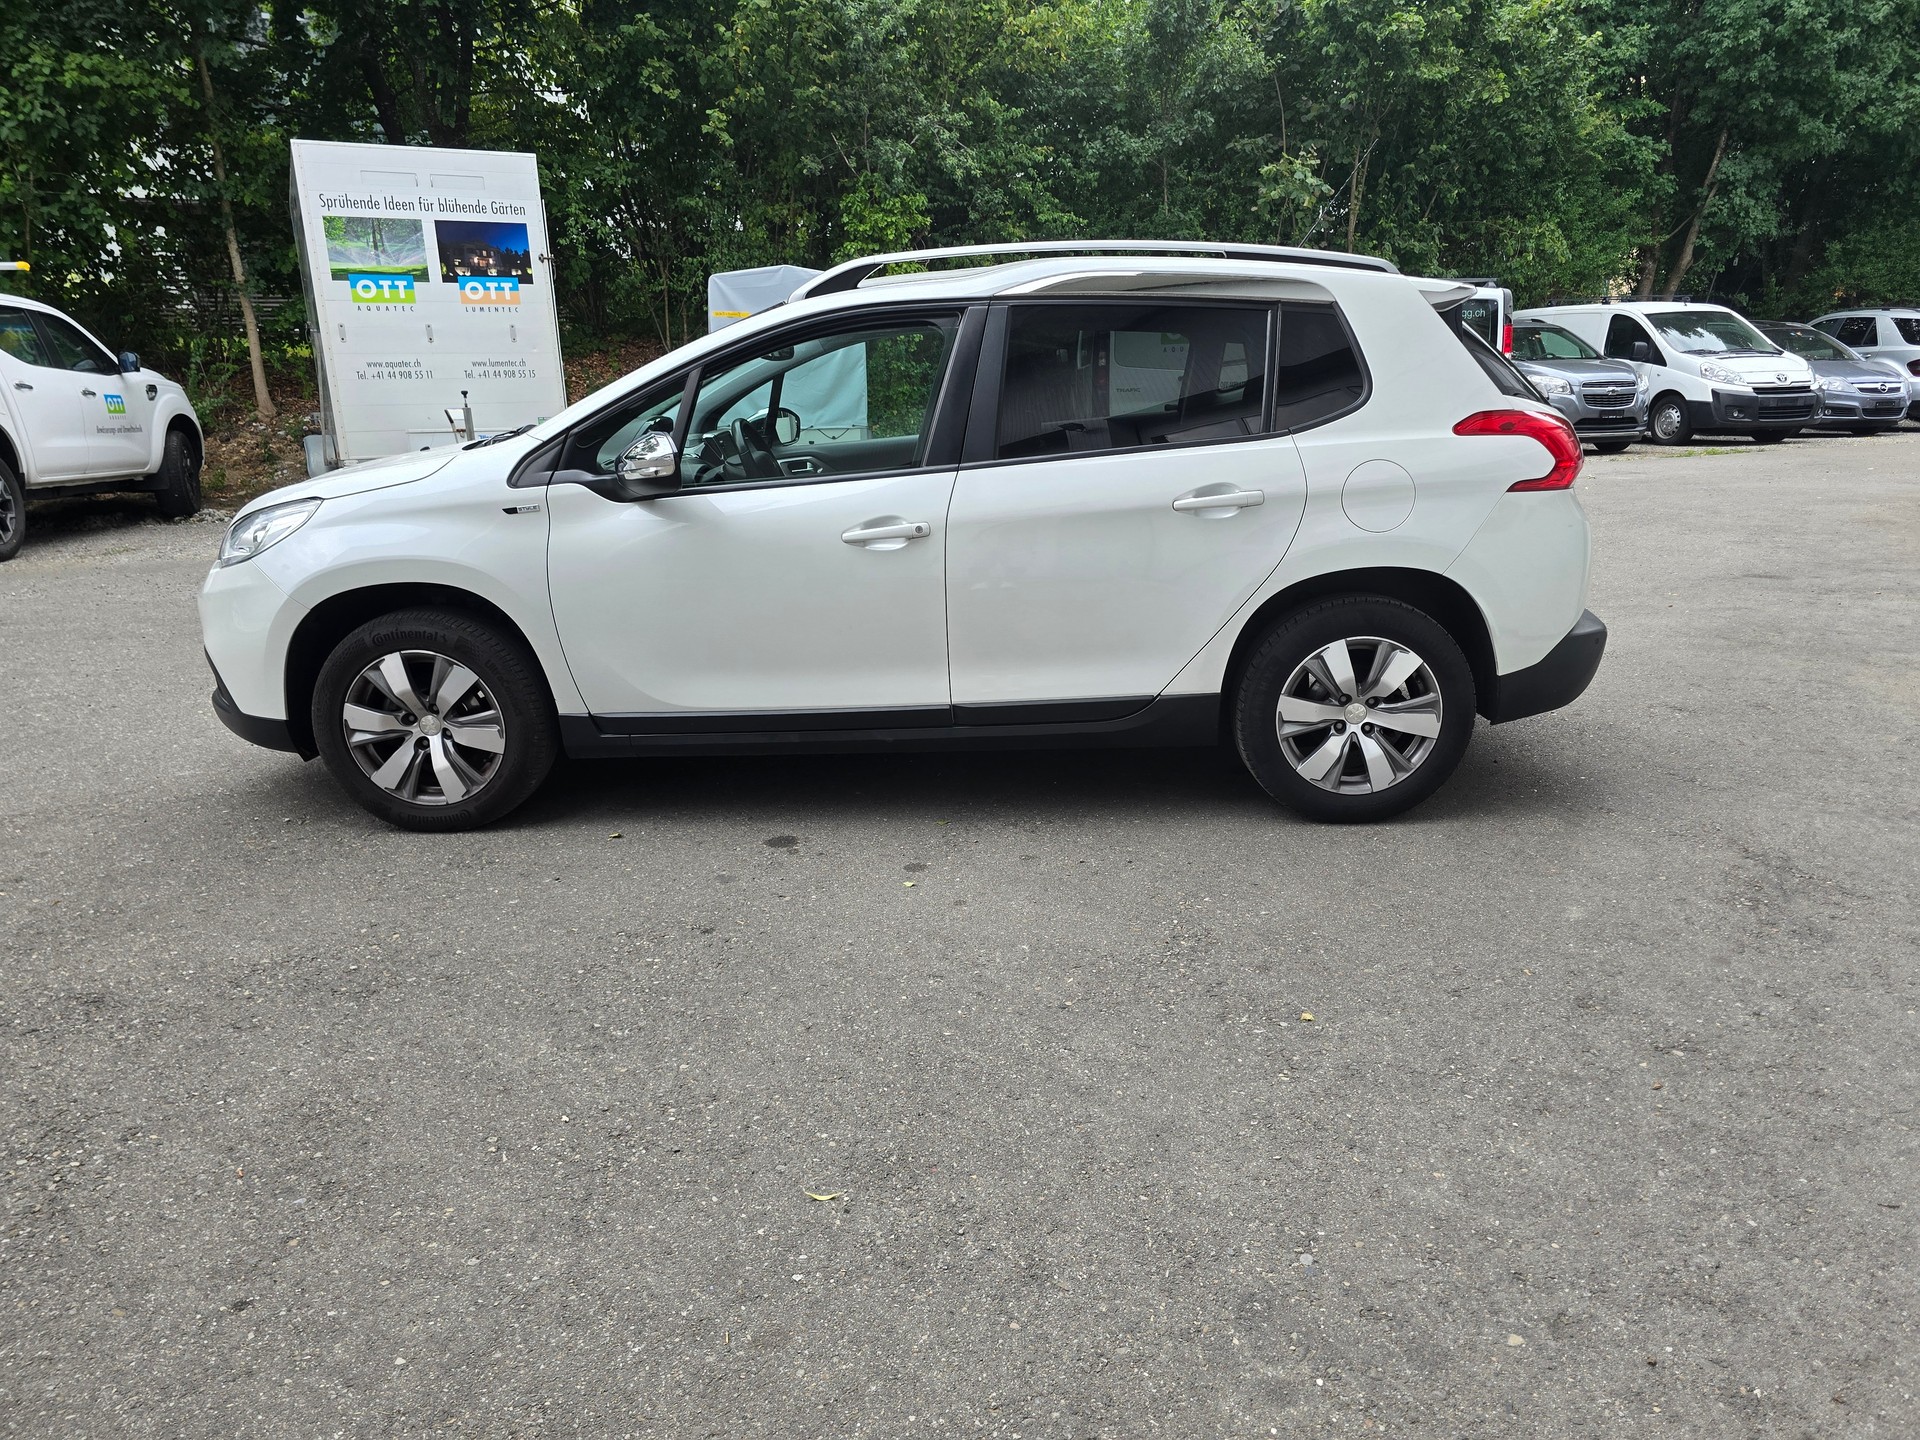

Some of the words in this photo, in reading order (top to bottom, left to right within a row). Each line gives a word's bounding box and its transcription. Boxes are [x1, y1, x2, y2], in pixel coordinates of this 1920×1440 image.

[318, 193, 381, 211] Sprühende
[383, 196, 415, 212] Ideen
[418, 196, 434, 213] für
[438, 198, 488, 215] blühende
[490, 201, 526, 216] Gärten
[356, 279, 408, 299] OTT
[464, 281, 513, 300] OTT
[366, 358, 421, 370] www.aquatec.ch
[471, 358, 527, 368] www.lumentec.ch
[356, 370, 369, 380] Tel.
[371, 370, 384, 380] +41
[387, 370, 397, 380] 44
[399, 370, 413, 380] 908
[415, 370, 424, 380] 55
[426, 370, 433, 380] 11
[464, 369, 476, 379] Tel.
[478, 369, 490, 379] +41
[492, 369, 502, 379] 44
[503, 369, 516, 379] 908
[518, 369, 527, 379] 55
[529, 369, 536, 379] 15
[107, 397, 123, 411] OTT
[371, 629, 438, 647] Continental
